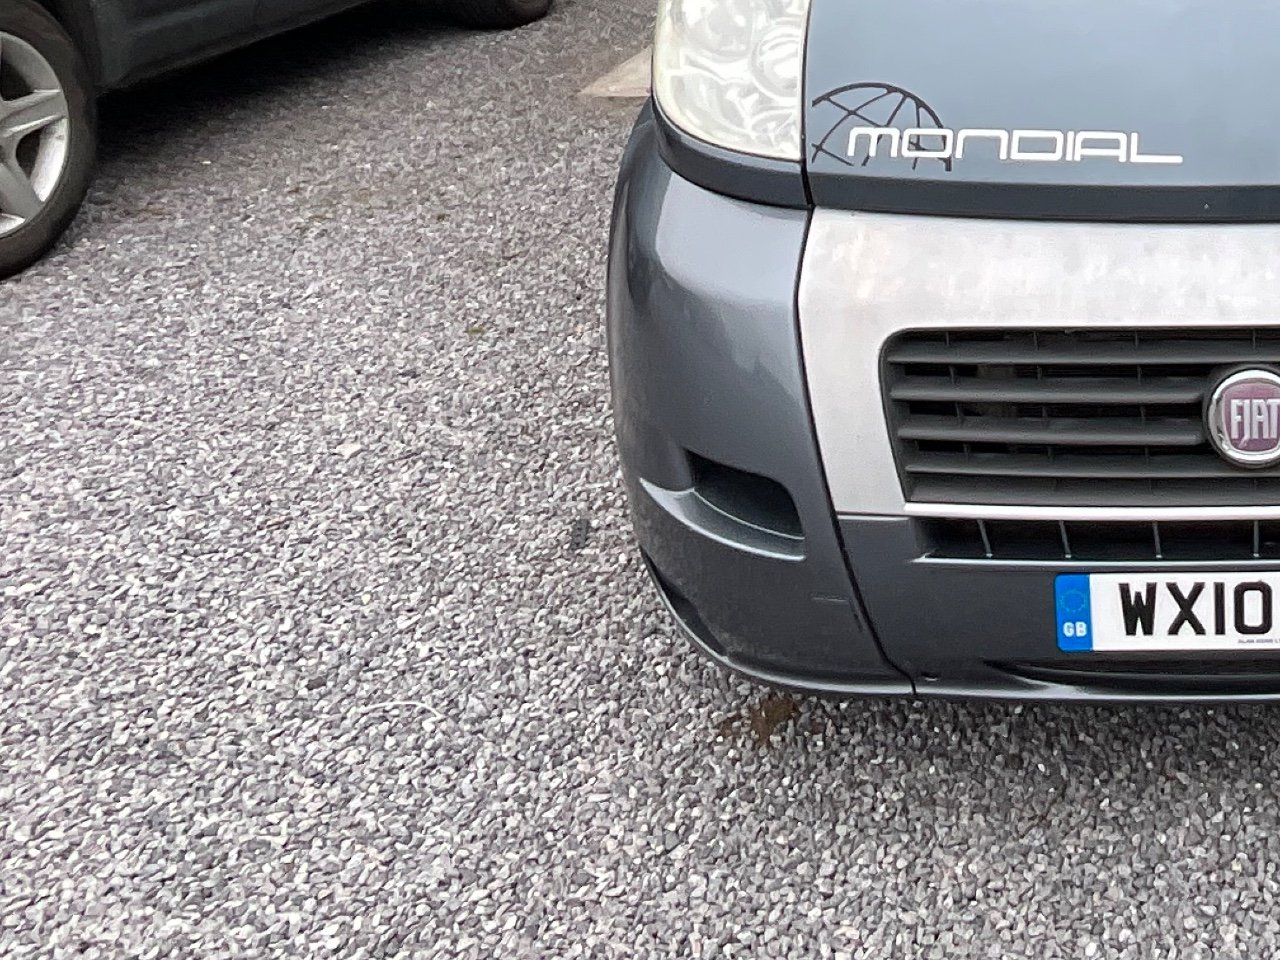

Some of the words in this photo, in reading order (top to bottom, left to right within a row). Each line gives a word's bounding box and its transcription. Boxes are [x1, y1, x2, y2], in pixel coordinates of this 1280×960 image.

[847, 126, 1184, 164] MONDIAL
[1118, 580, 1274, 637] WX10
[1062, 621, 1087, 638] GB
